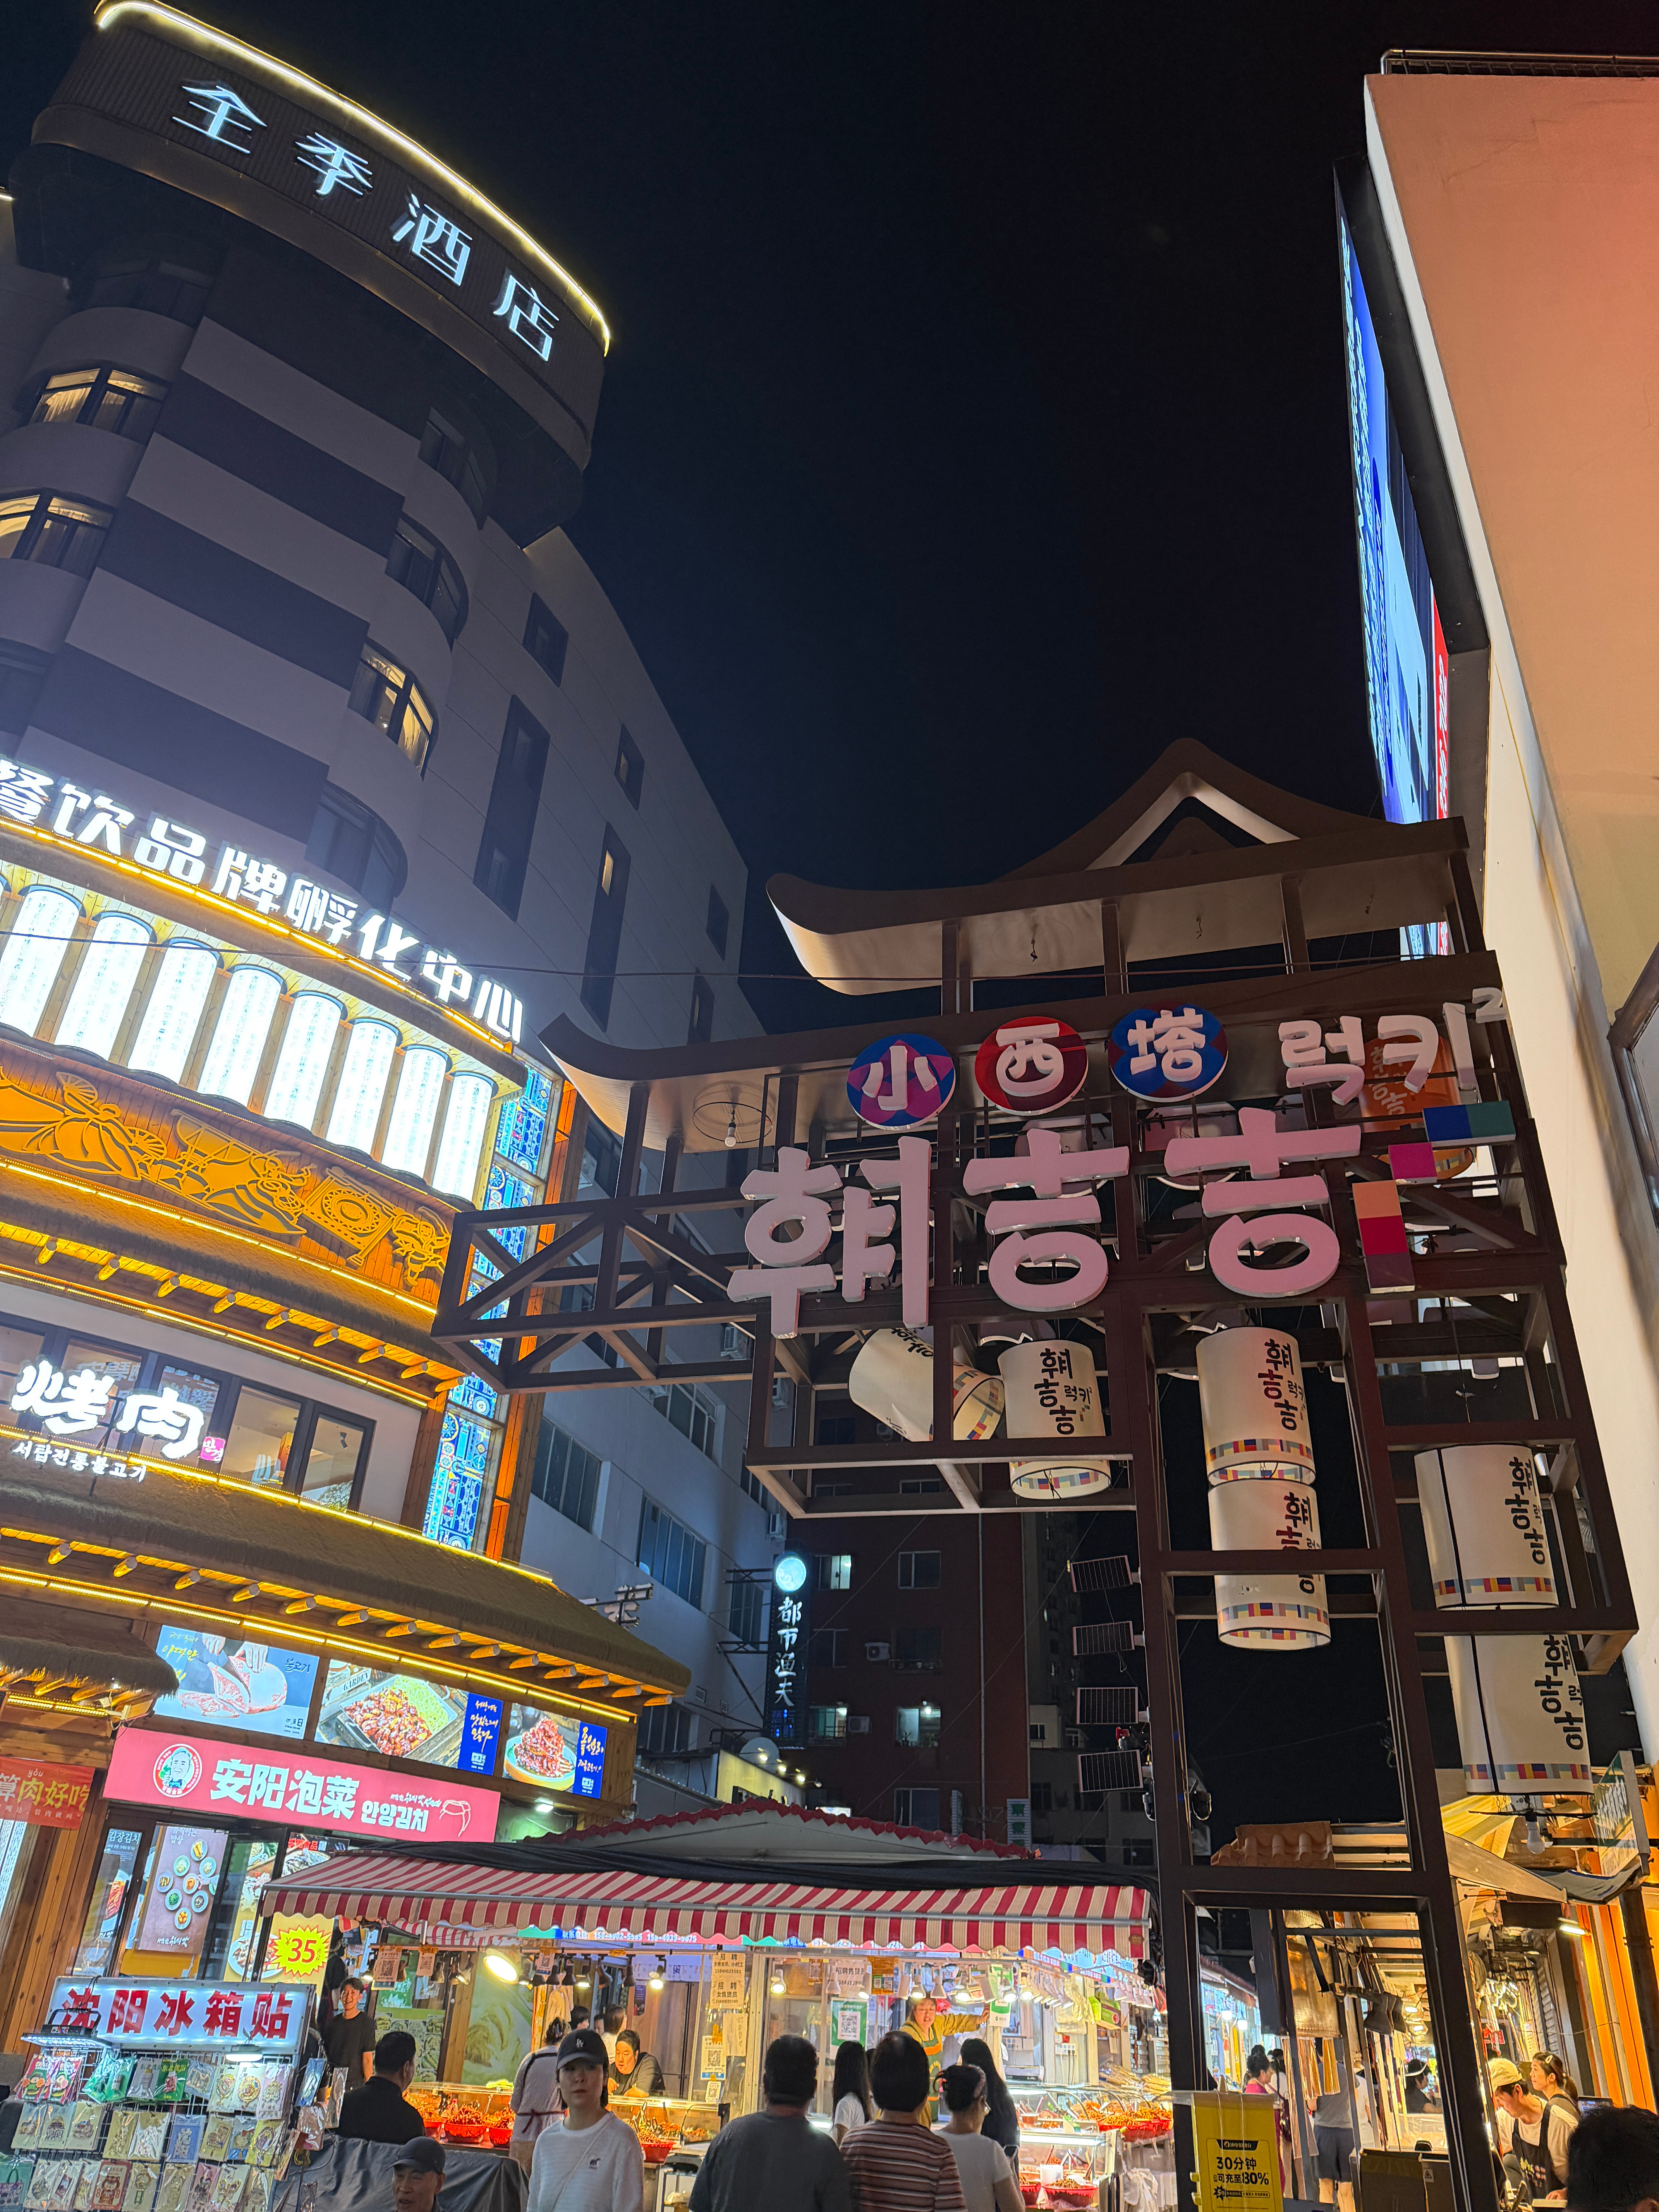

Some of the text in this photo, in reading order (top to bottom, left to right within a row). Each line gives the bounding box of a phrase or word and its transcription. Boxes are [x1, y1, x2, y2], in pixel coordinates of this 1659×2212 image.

[172, 85, 559, 361] 全季酒店
[0, 760, 524, 1044] 餐饮品牌孵化中心
[862, 1007, 1206, 1111] 小西塔
[10, 1360, 204, 1460] 烤肉
[285, 1658, 310, 1673] 불고기
[774, 1596, 803, 1707] 都市渔夫
[343, 1673, 369, 1692] GARDEN
[210, 1758, 361, 1820] 安阳泡菜
[109, 1831, 141, 1845] 김장김치
[361, 1800, 429, 1832] 안양김치
[718, 1982, 737, 1990] 招聘
[62, 1987, 293, 2039] 沈阳冰箱贴
[1216, 2156, 1257, 2171] 30分钟
